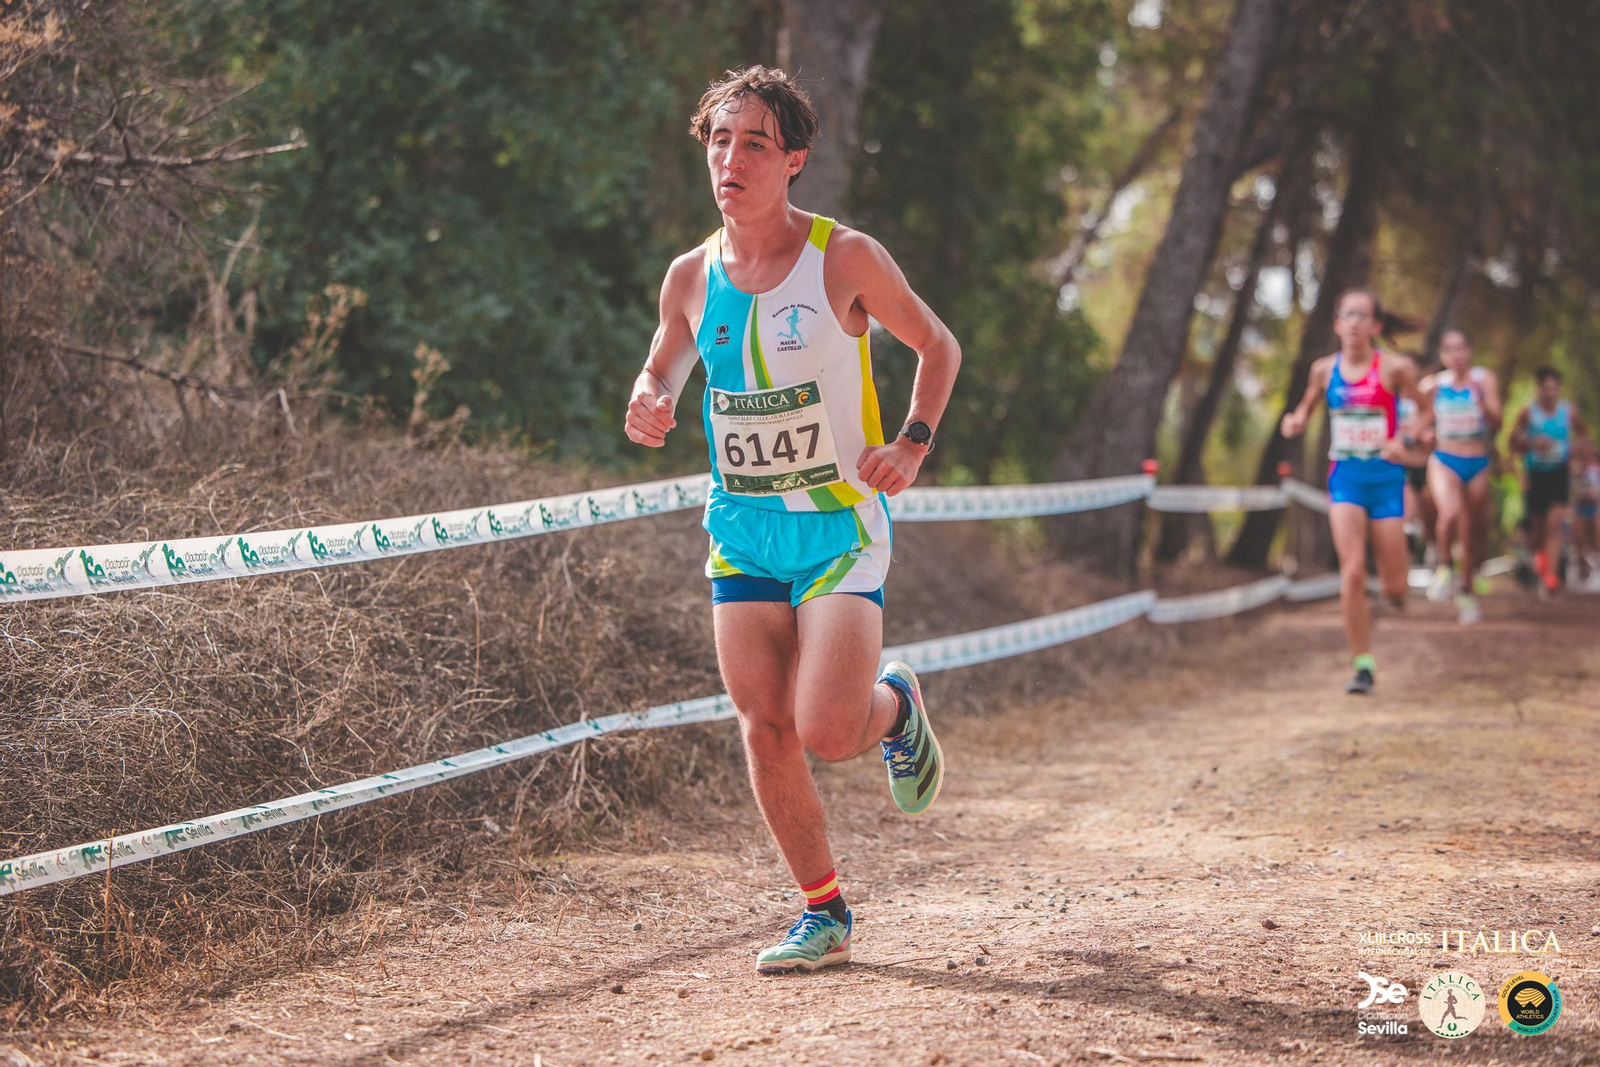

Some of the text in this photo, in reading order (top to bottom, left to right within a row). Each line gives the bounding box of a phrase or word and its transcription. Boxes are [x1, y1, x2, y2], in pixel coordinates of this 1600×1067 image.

[734, 393, 790, 409] ITÁLICA
[724, 422, 820, 467] 6147
[184, 823, 215, 840] Sevilla
